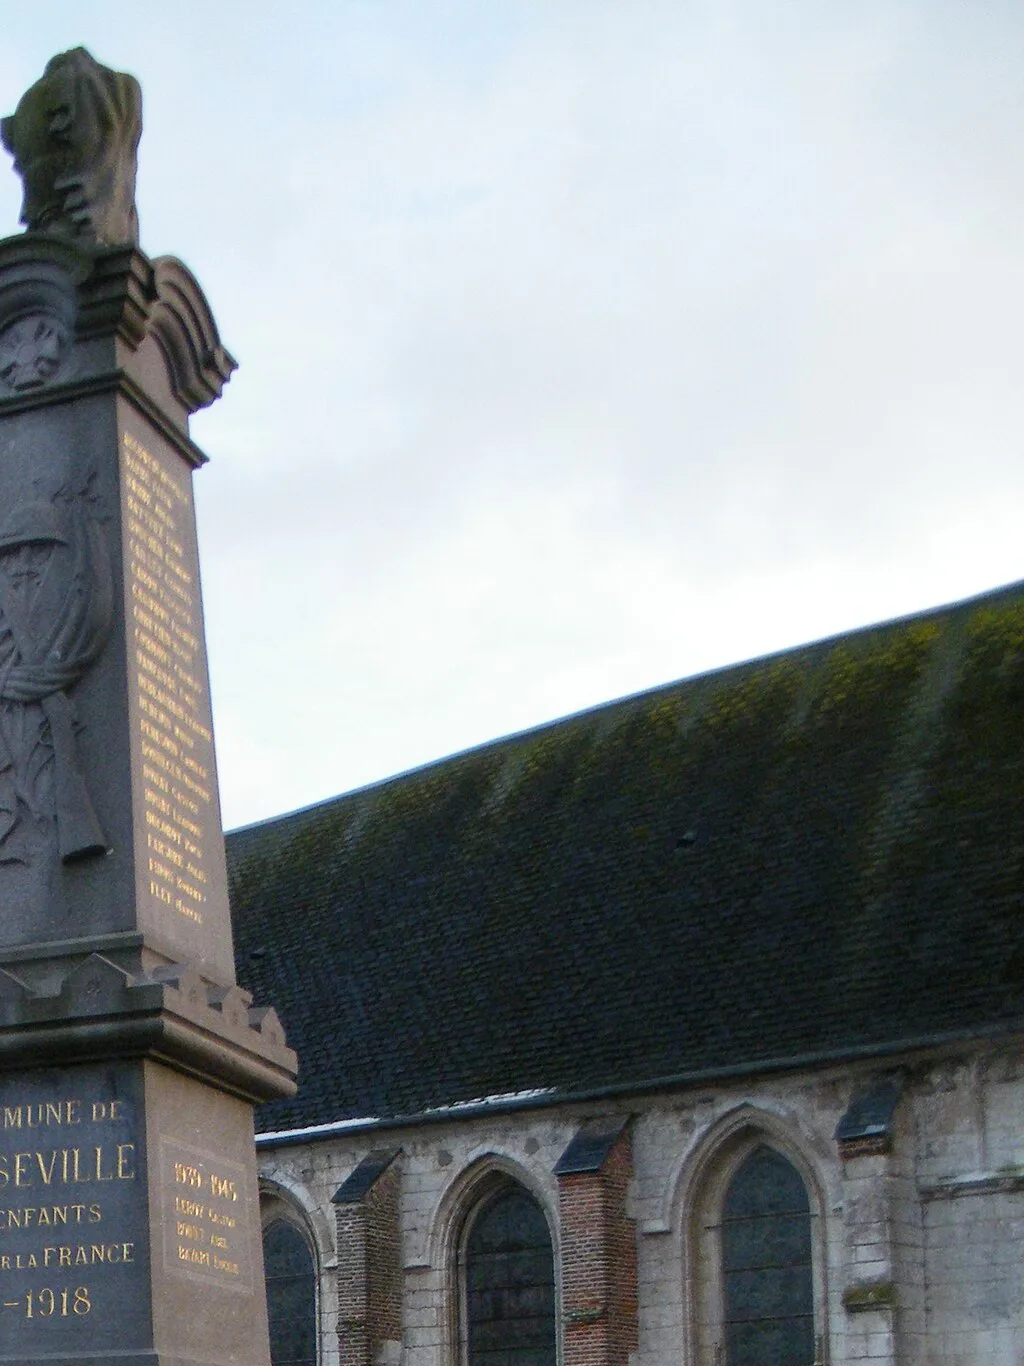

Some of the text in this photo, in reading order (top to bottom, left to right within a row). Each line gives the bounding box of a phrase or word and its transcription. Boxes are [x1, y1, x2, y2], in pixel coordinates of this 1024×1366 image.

[91, 1100, 123, 1122] DE
[16, 1253, 38, 1269] LA
[43, 1243, 134, 1267] FRANCE
